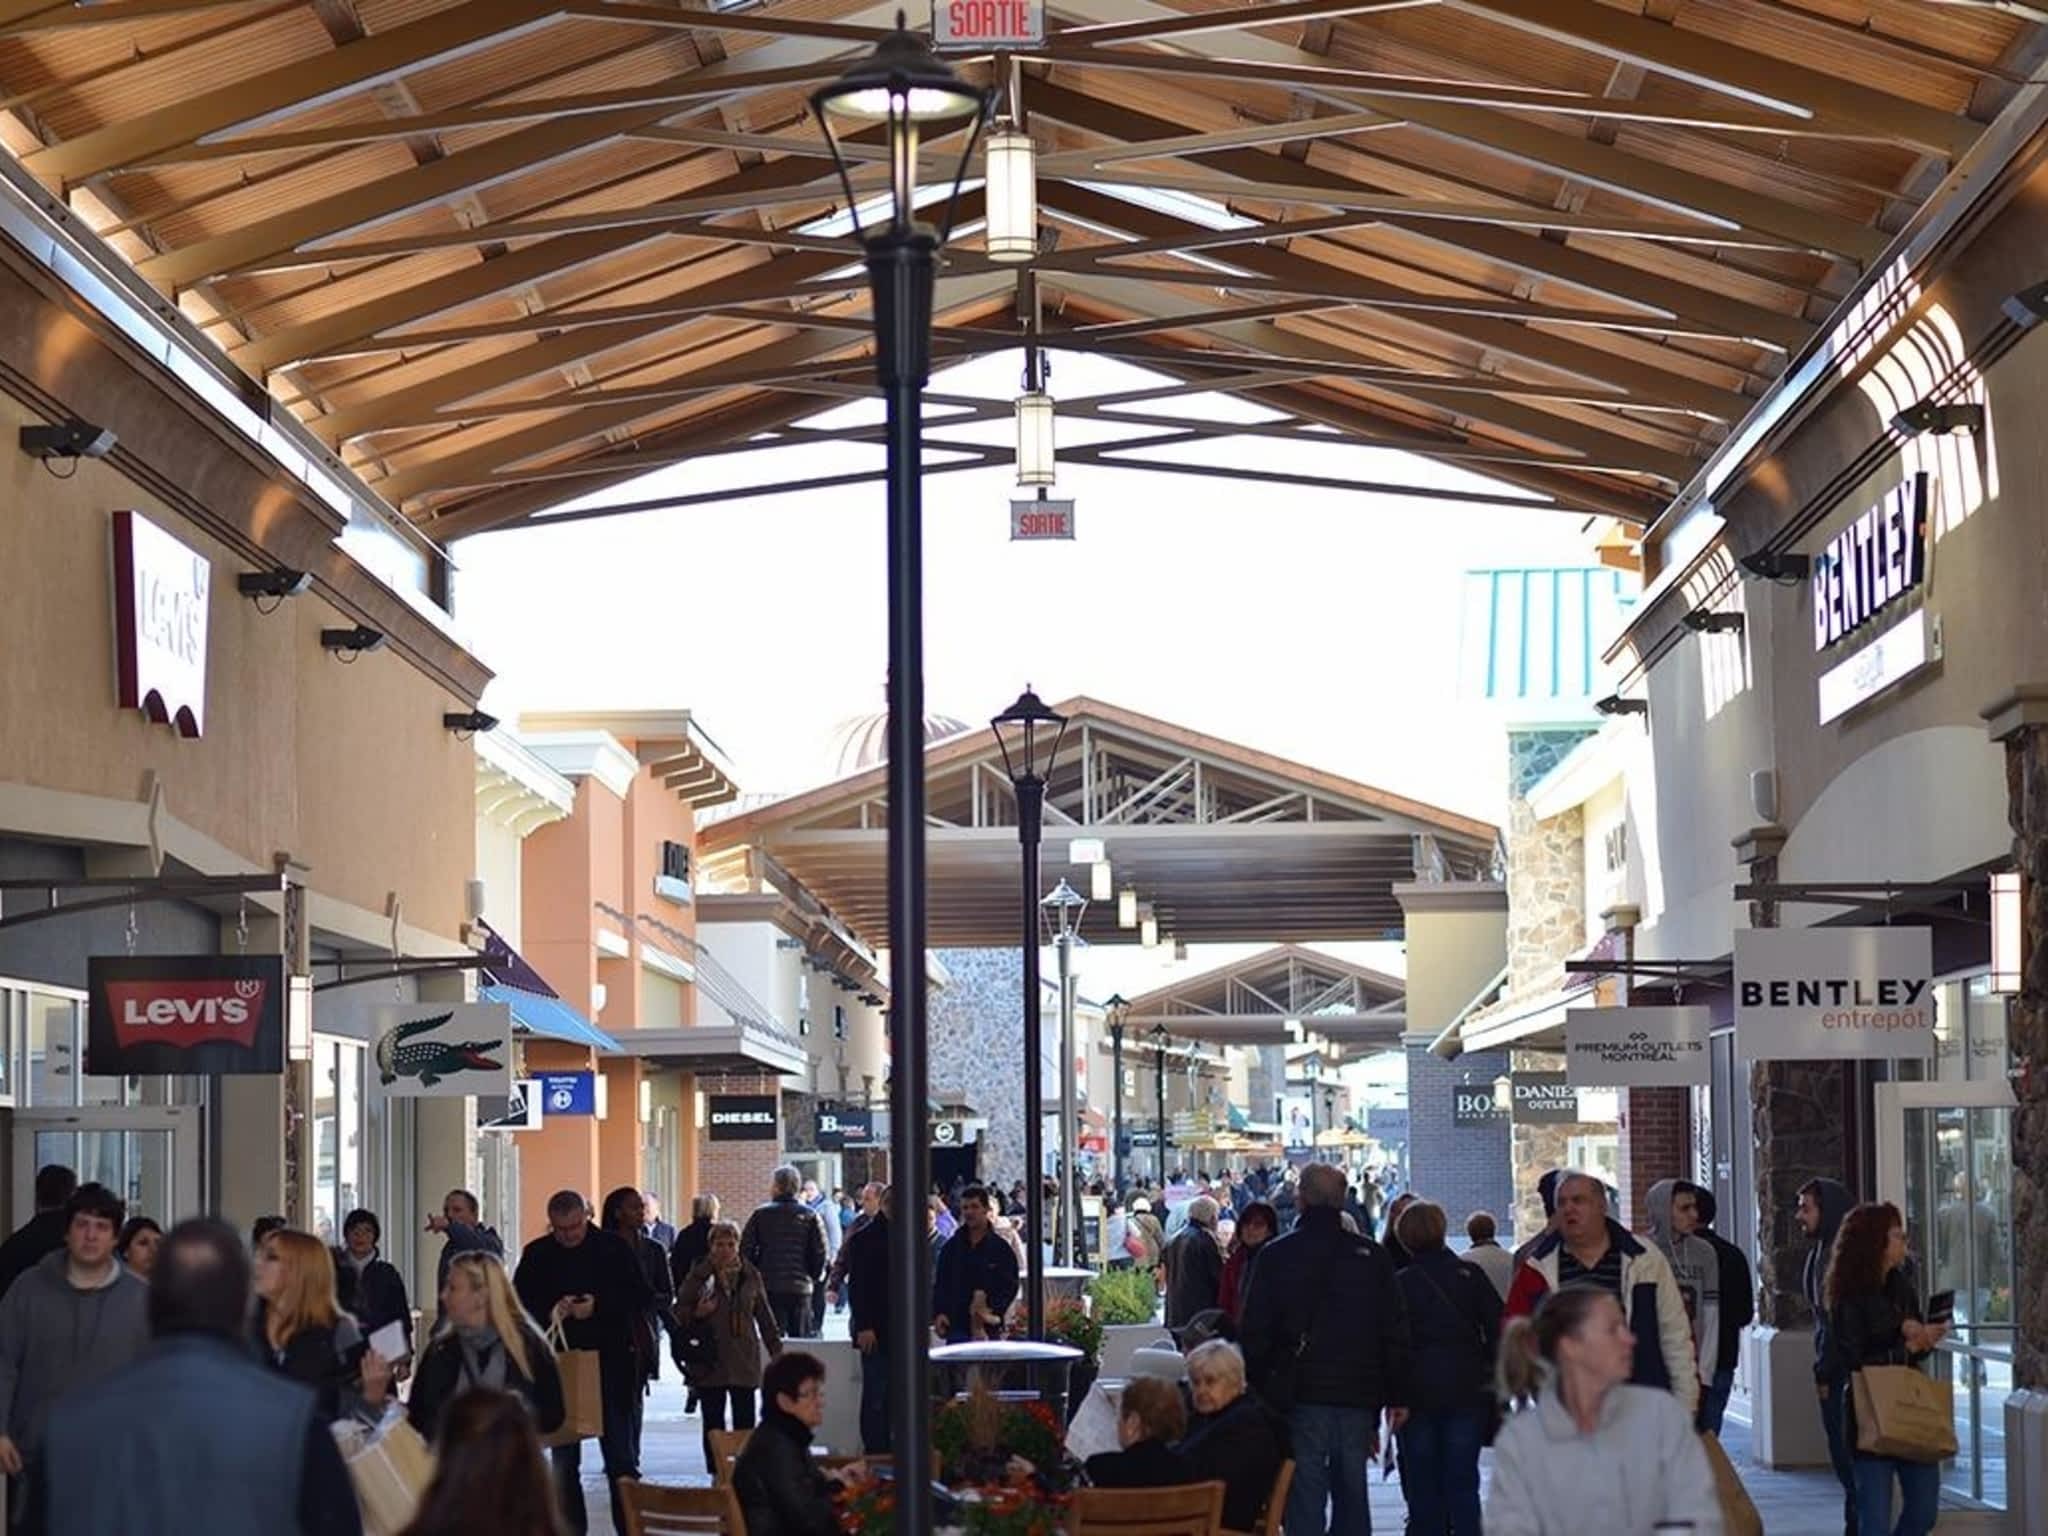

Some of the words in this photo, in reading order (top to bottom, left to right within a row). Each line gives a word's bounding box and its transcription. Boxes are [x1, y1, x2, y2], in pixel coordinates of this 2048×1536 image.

[951, 0, 1030, 38] SORTIE
[1020, 512, 1066, 535] SORTIE
[1814, 474, 1921, 652] BENTLEY
[1741, 979, 1928, 1006] BENTLEY
[1822, 1008, 1928, 1032] entrepôt
[1575, 1042, 1638, 1052] PREMIUM
[1641, 1042, 1703, 1052] OUTLETS
[1514, 1086, 1577, 1099] DANIE
[1528, 1100, 1575, 1109] OUTLET
[712, 1112, 774, 1124] DIESEL
